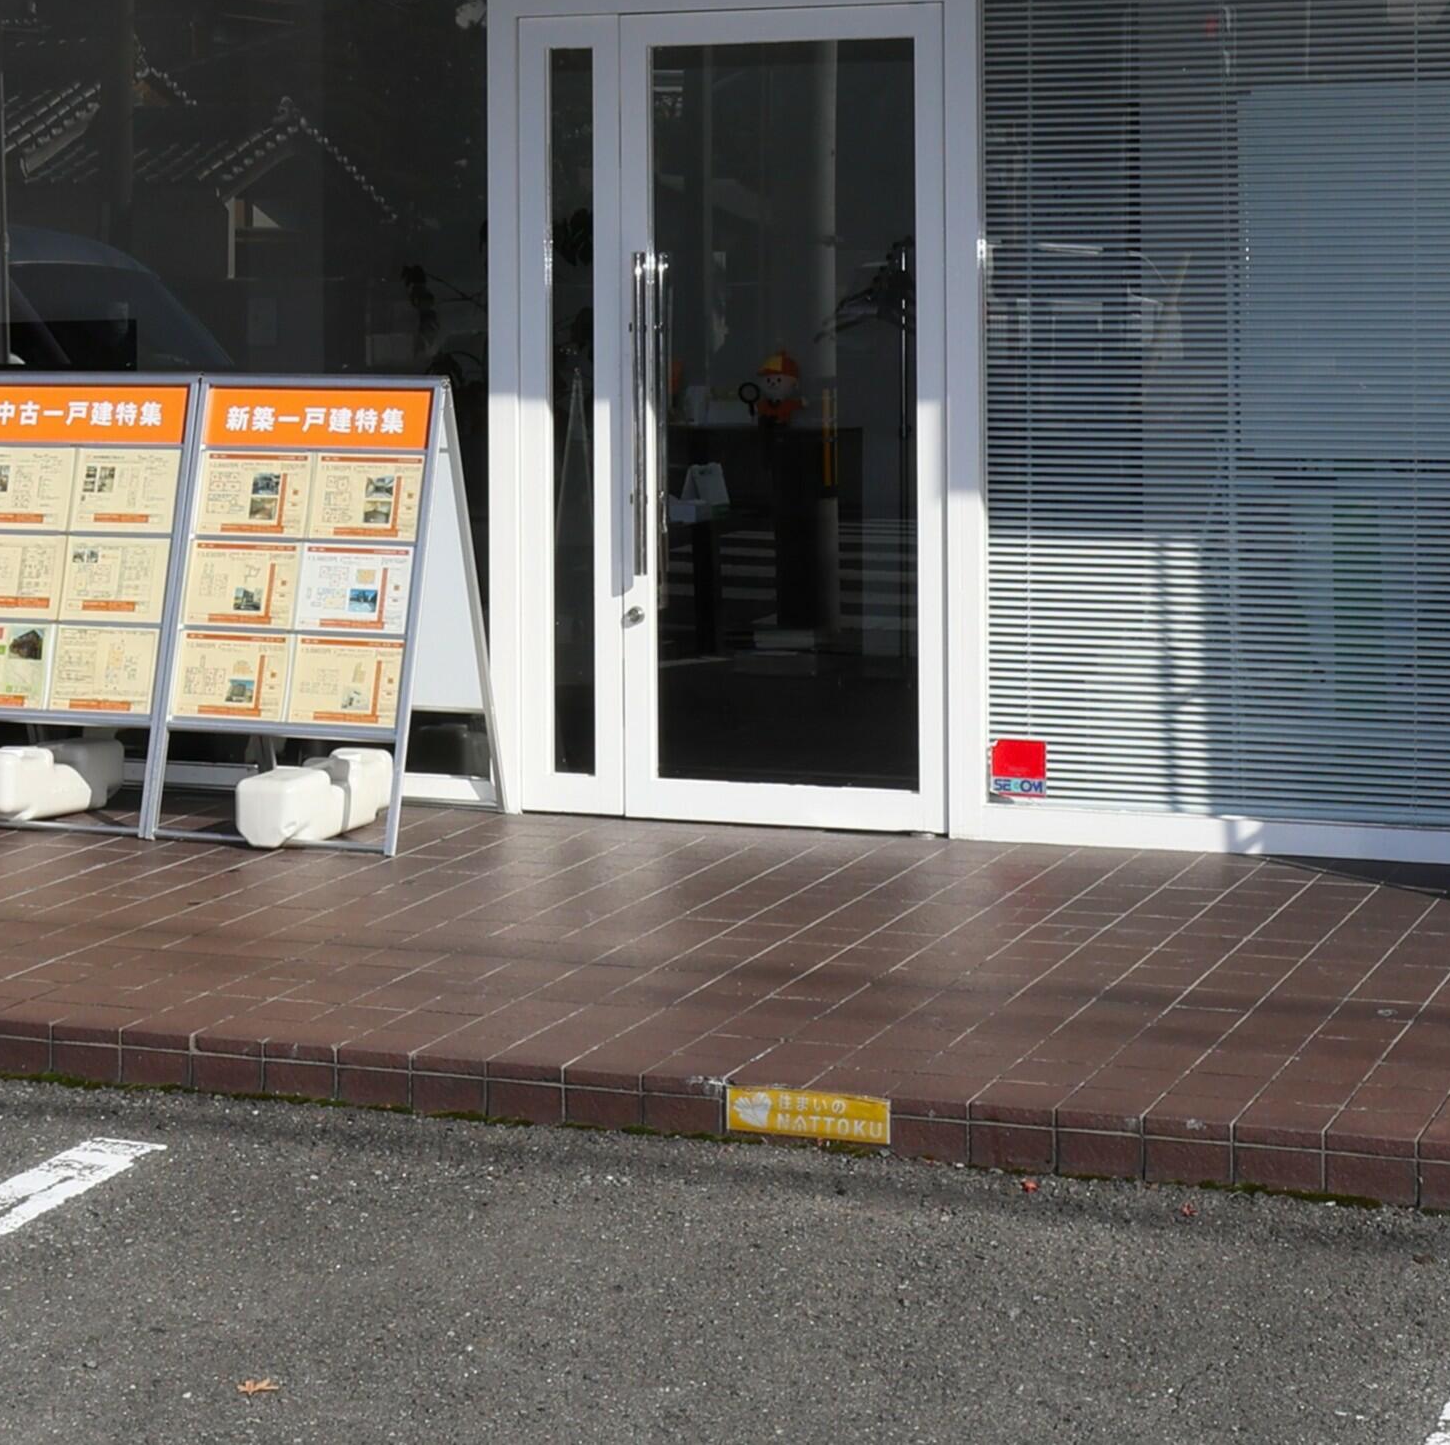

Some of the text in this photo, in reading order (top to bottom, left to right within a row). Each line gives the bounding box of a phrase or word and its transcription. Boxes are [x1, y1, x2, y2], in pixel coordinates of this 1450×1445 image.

[225, 406, 406, 434] 新築一戸建特集
[776, 1113, 883, 1139] NATTOKU
